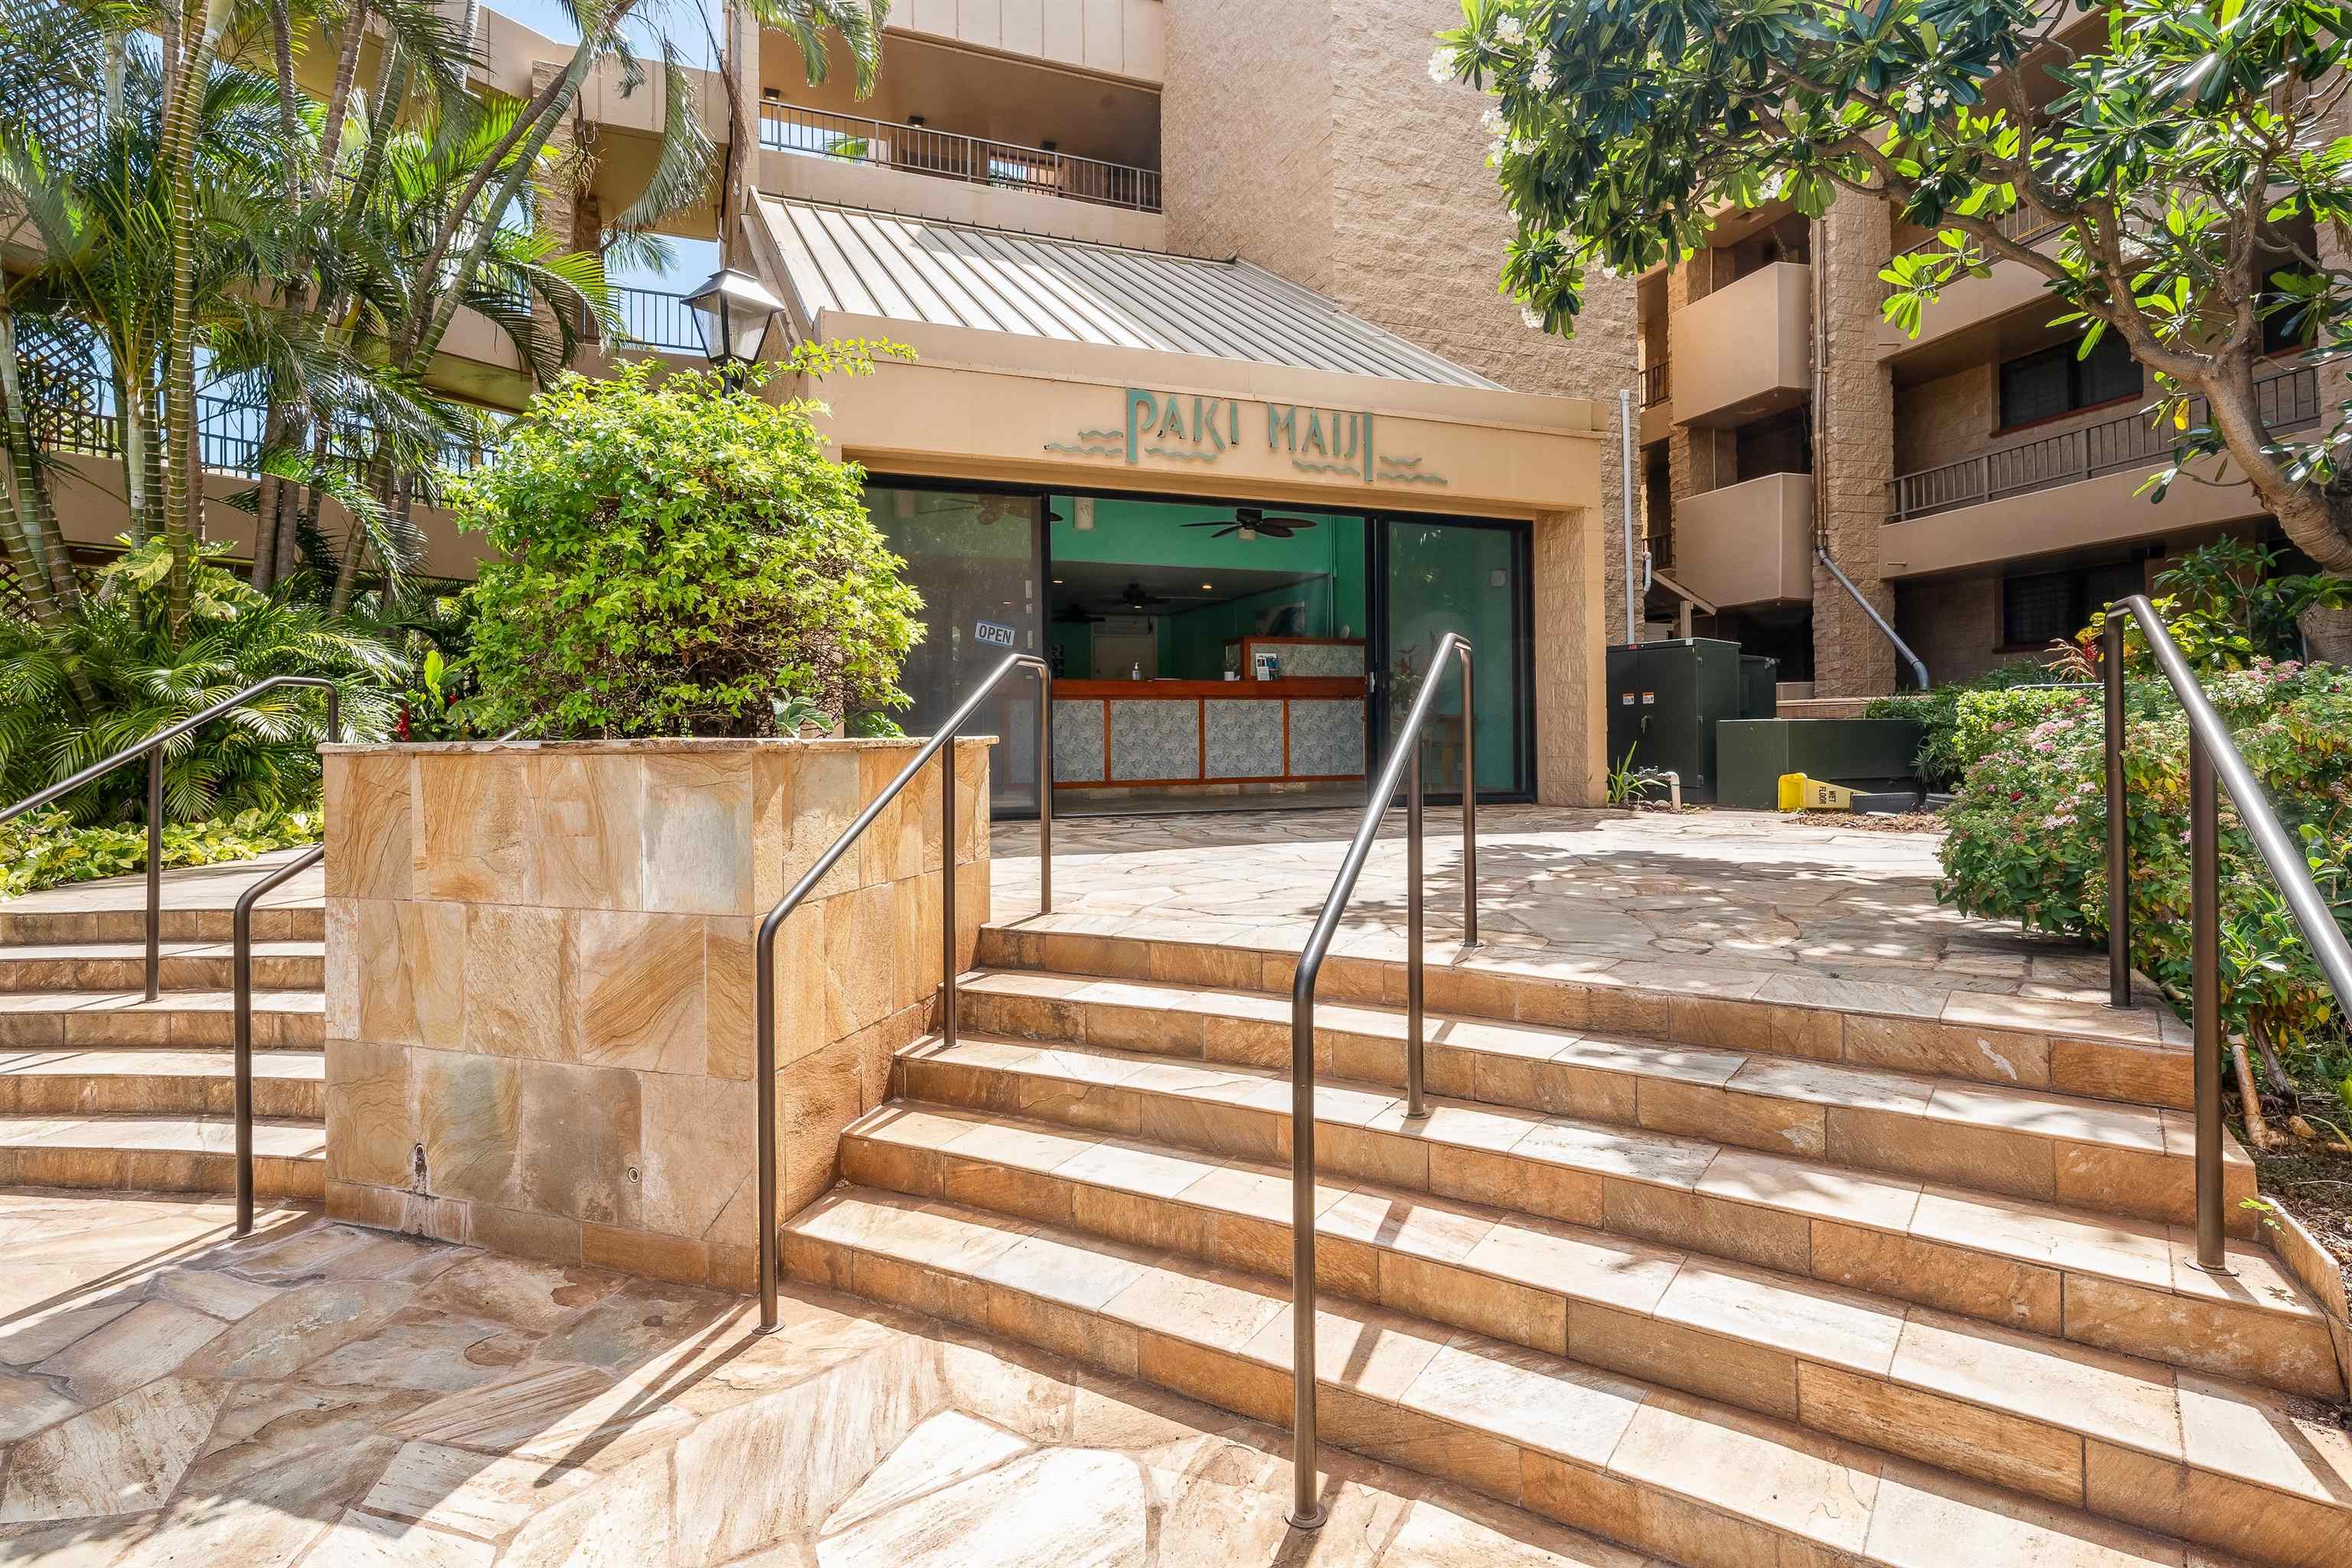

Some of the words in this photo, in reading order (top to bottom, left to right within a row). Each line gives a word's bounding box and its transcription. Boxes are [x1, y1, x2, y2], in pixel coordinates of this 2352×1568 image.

[1125, 387, 1240, 464] PAKI
[1267, 402, 1374, 482] MAUI
[979, 625, 1011, 644] OPEN
[1828, 790, 1837, 802] WET
